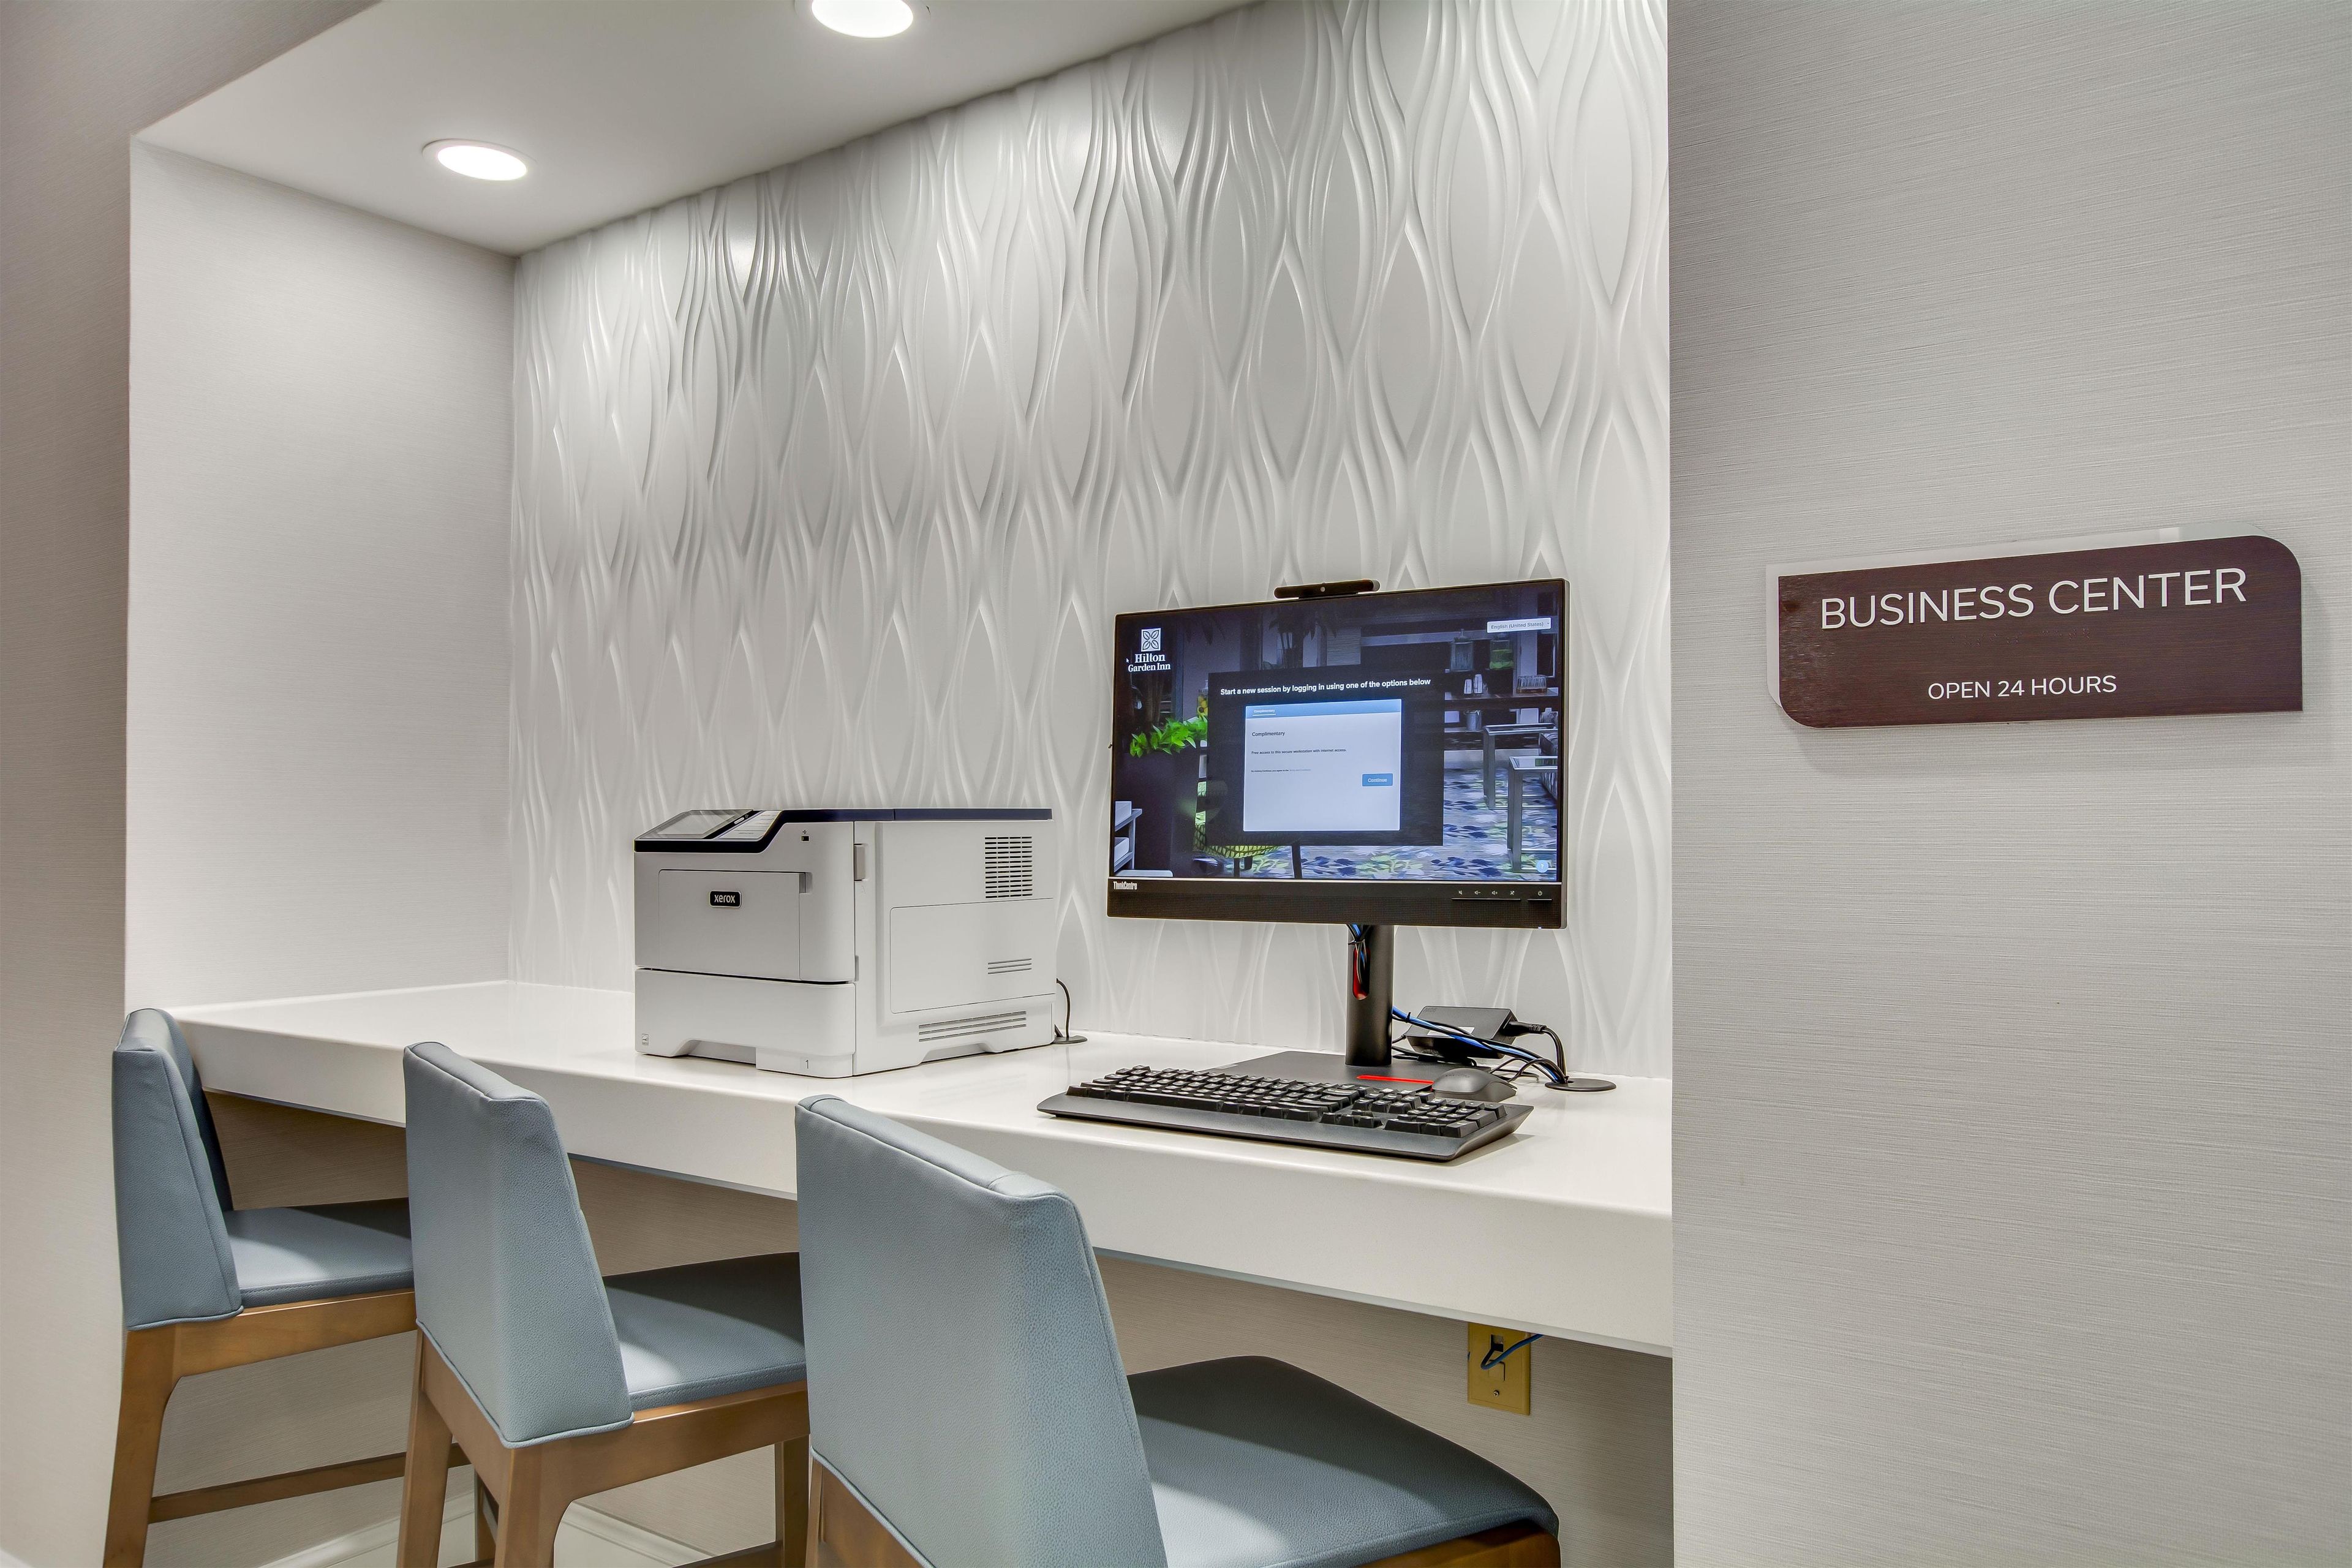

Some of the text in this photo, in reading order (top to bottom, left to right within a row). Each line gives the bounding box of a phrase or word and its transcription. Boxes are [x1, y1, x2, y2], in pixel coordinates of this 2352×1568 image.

[1821, 567, 2247, 629] BUSINESS CENTER
[1134, 653, 1166, 663] Hilton
[1128, 663, 1156, 672] Garden
[1292, 684, 1316, 693] logging
[1326, 682, 1344, 691] using
[1381, 679, 1408, 688] options
[1928, 675, 2117, 699] OPEN 24 HOURS
[714, 894, 736, 903] xerox
[805, 1060, 809, 1069] 1
